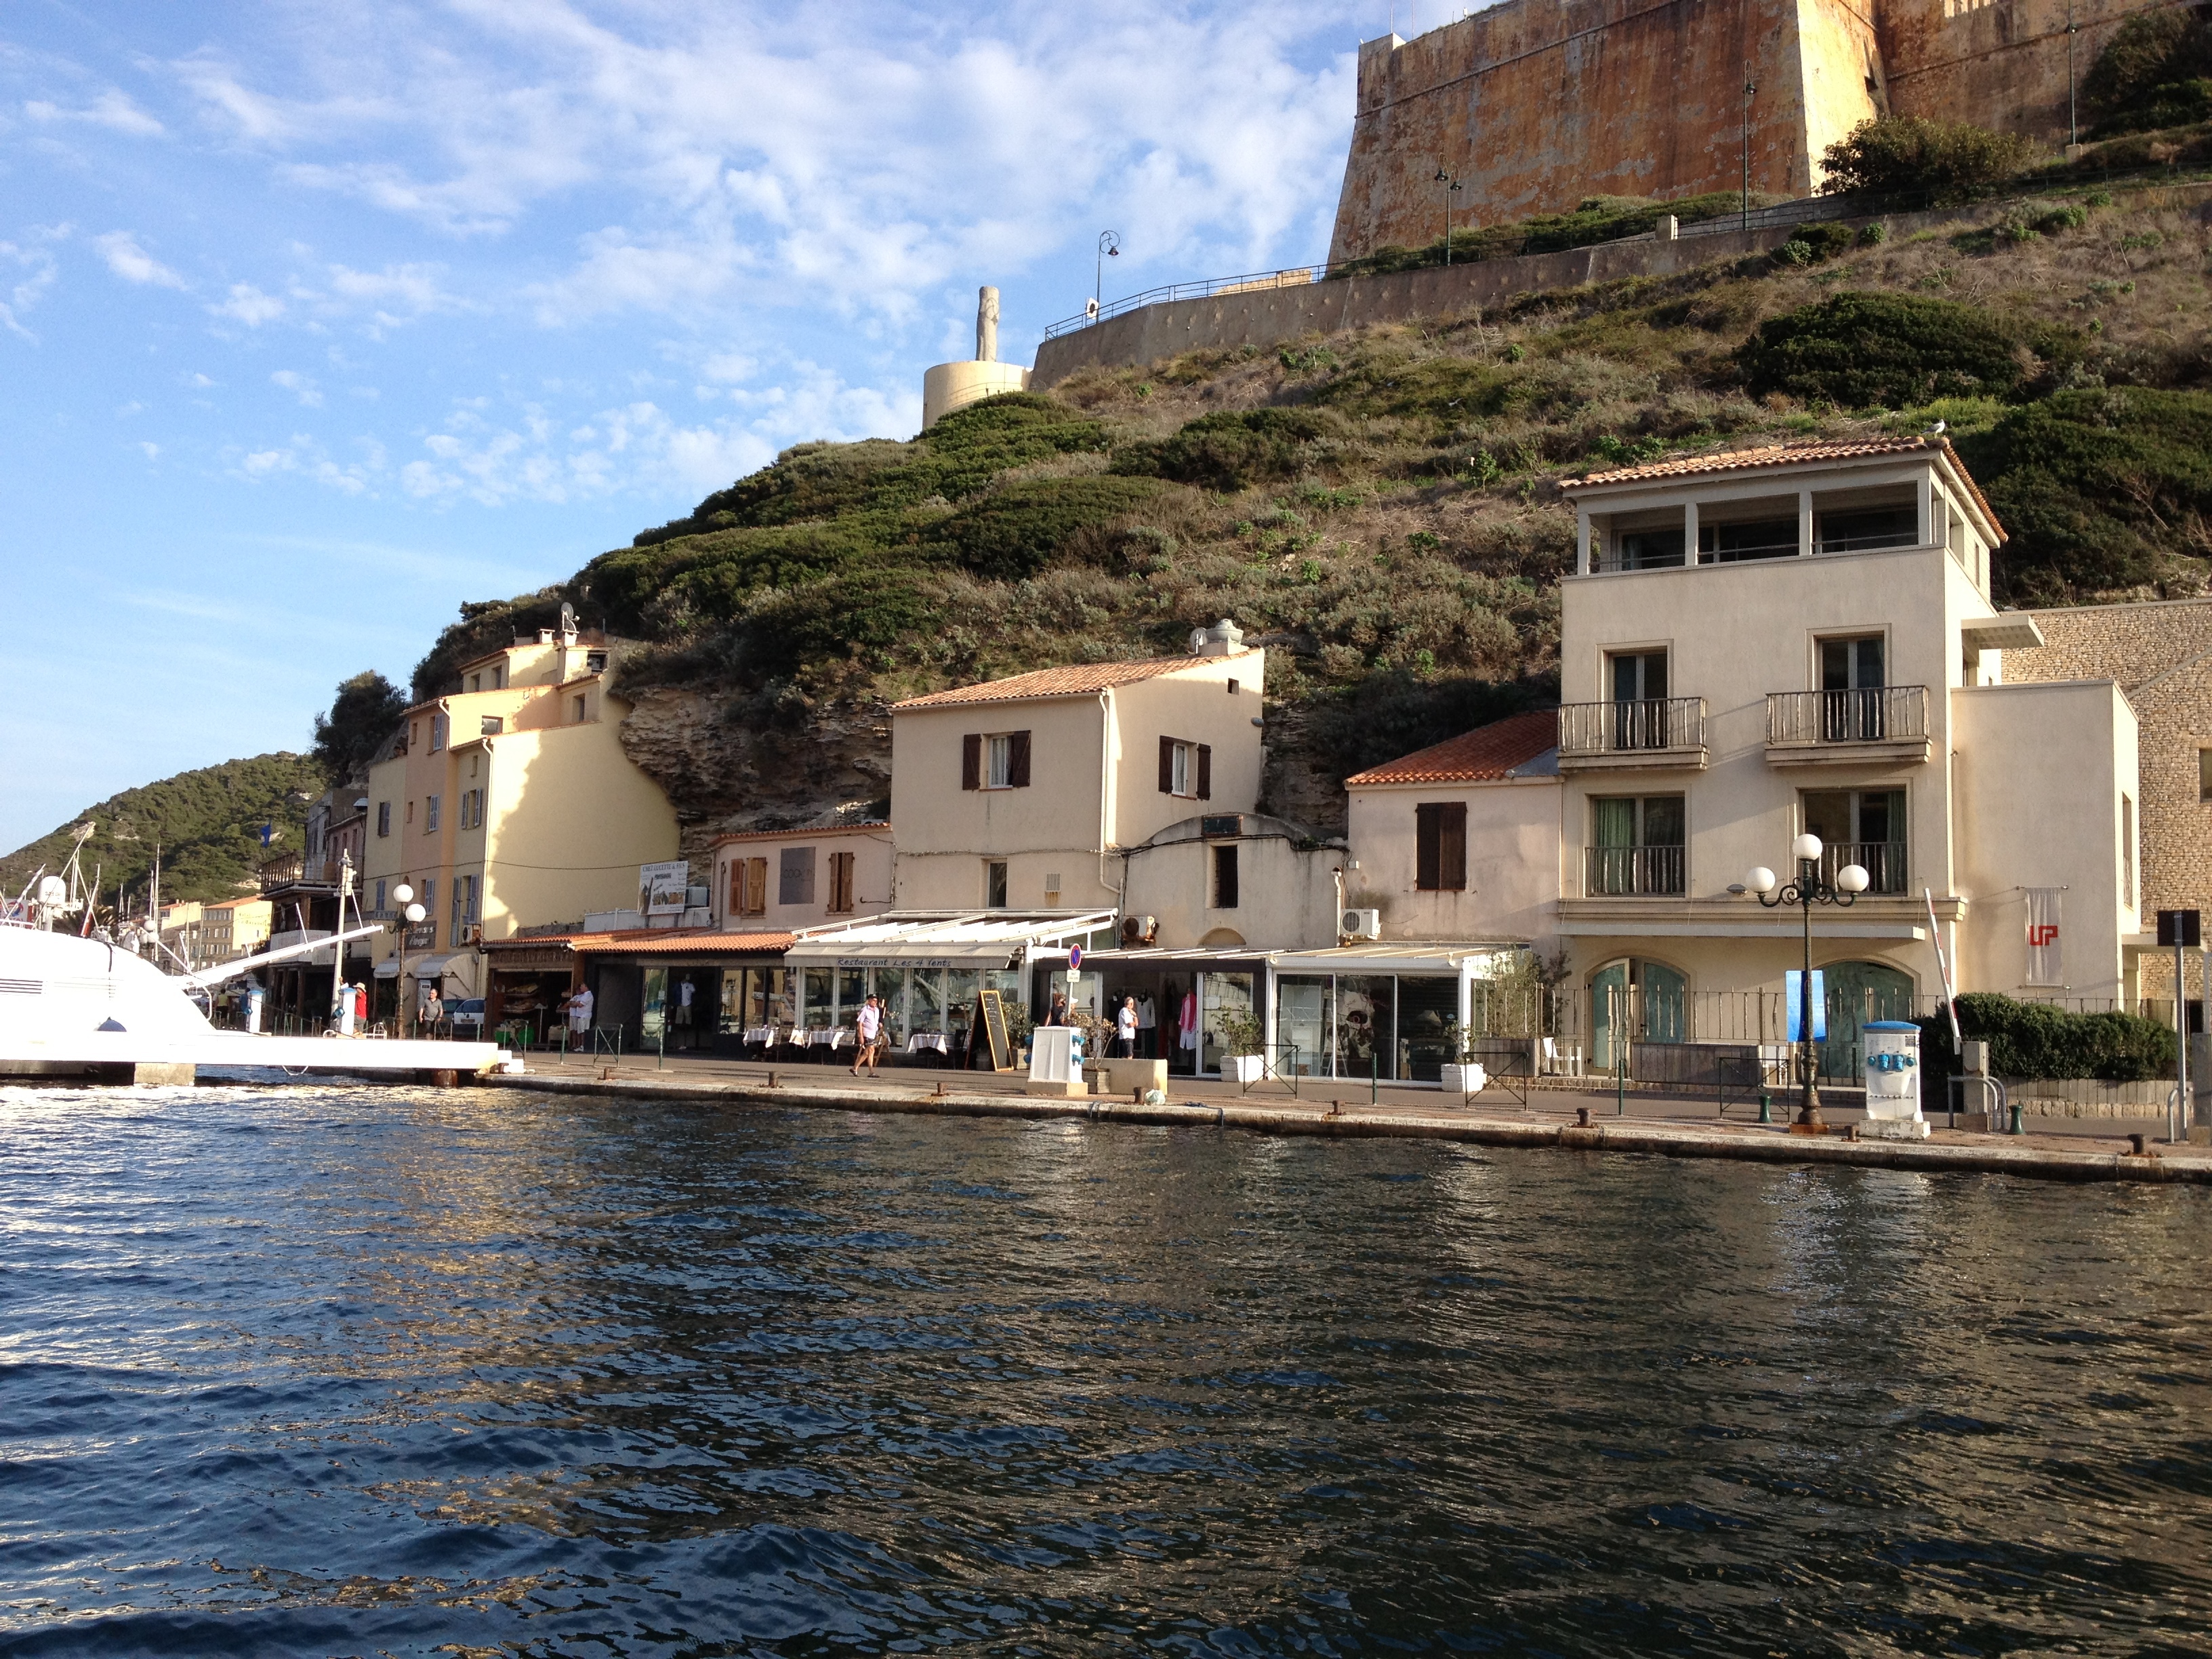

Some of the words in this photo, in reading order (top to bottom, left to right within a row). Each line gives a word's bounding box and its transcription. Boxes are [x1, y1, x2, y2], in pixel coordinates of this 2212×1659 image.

[837, 958, 888, 966] Restaurant
[916, 958, 924, 966] 4
[928, 958, 951, 966] Vents
